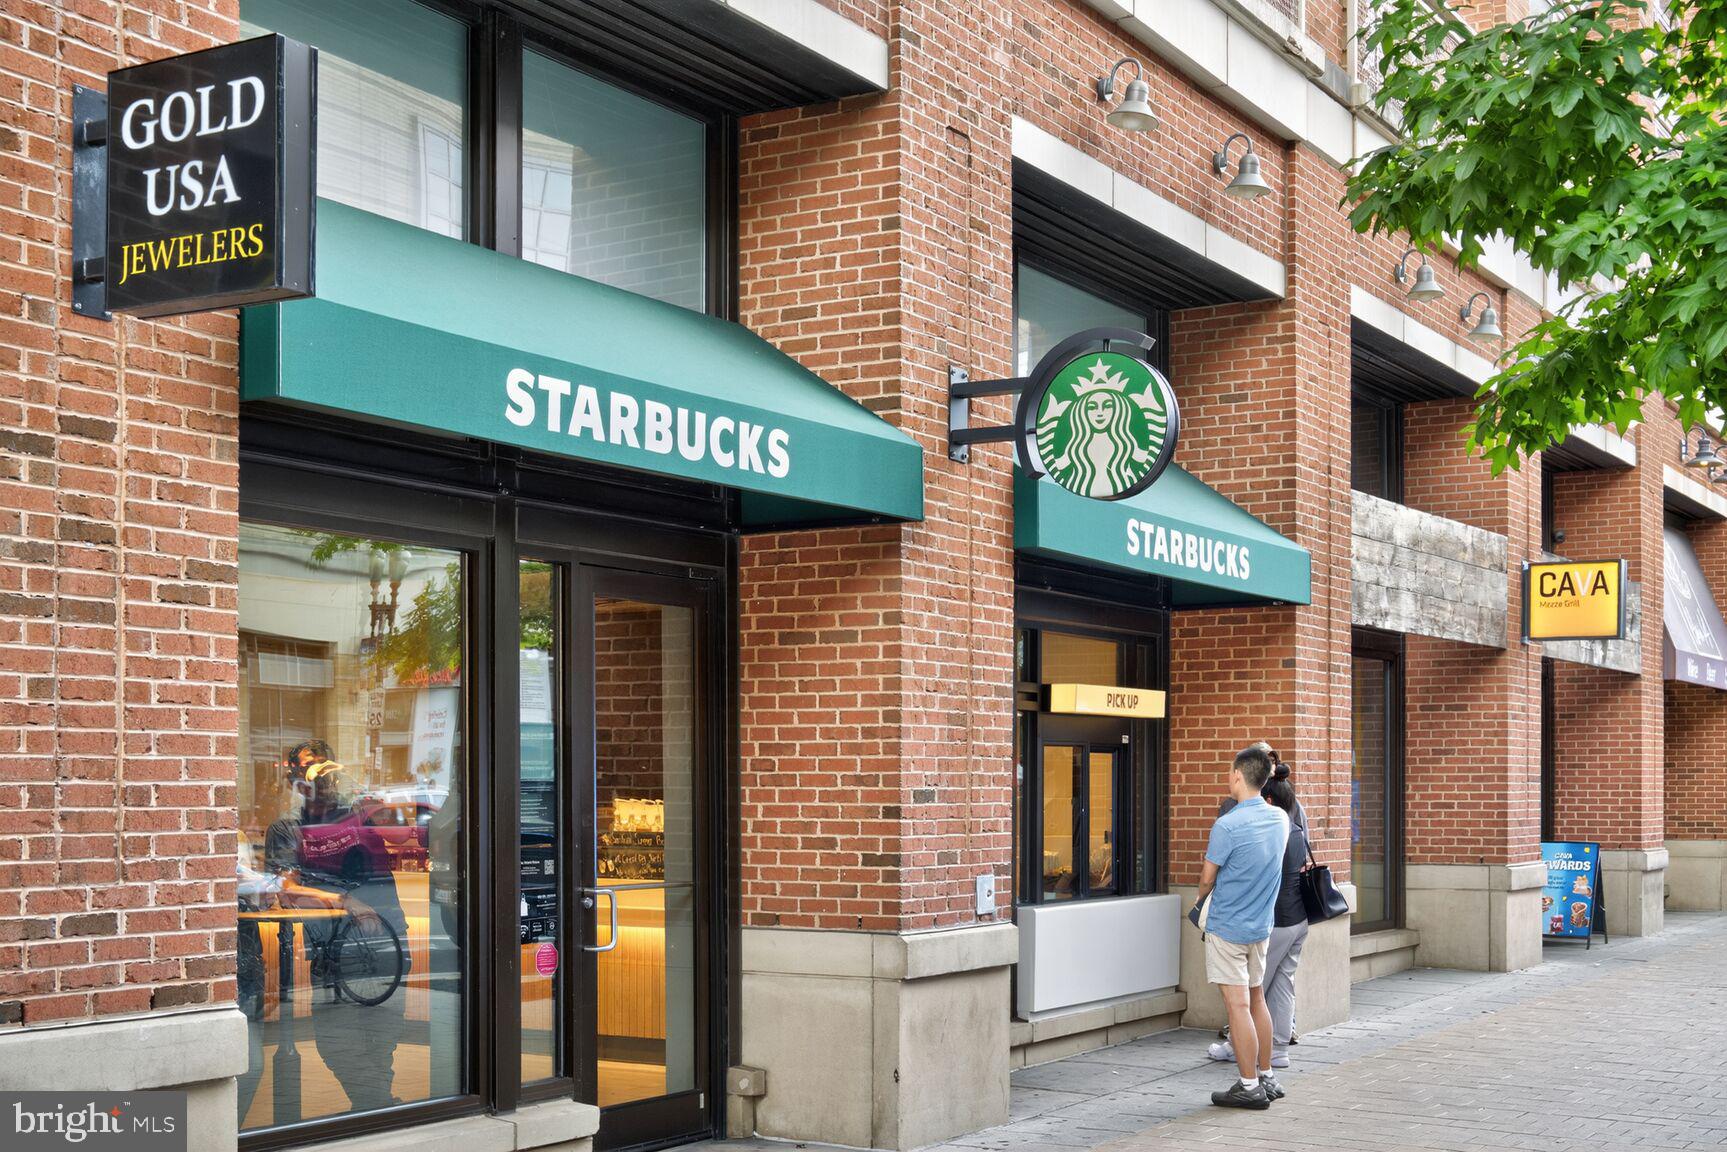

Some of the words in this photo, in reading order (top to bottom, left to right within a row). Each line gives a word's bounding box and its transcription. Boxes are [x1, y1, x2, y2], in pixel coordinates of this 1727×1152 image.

[121, 75, 266, 150] GOLD
[142, 154, 241, 216] USA
[119, 223, 265, 285] JEWELERS
[505, 368, 790, 478] STARBUCKS
[1126, 518, 1251, 580] STARBUCKS
[1539, 569, 1609, 598] CAVA
[1107, 693, 1126, 709] PICK
[1127, 694, 1139, 709] UP
